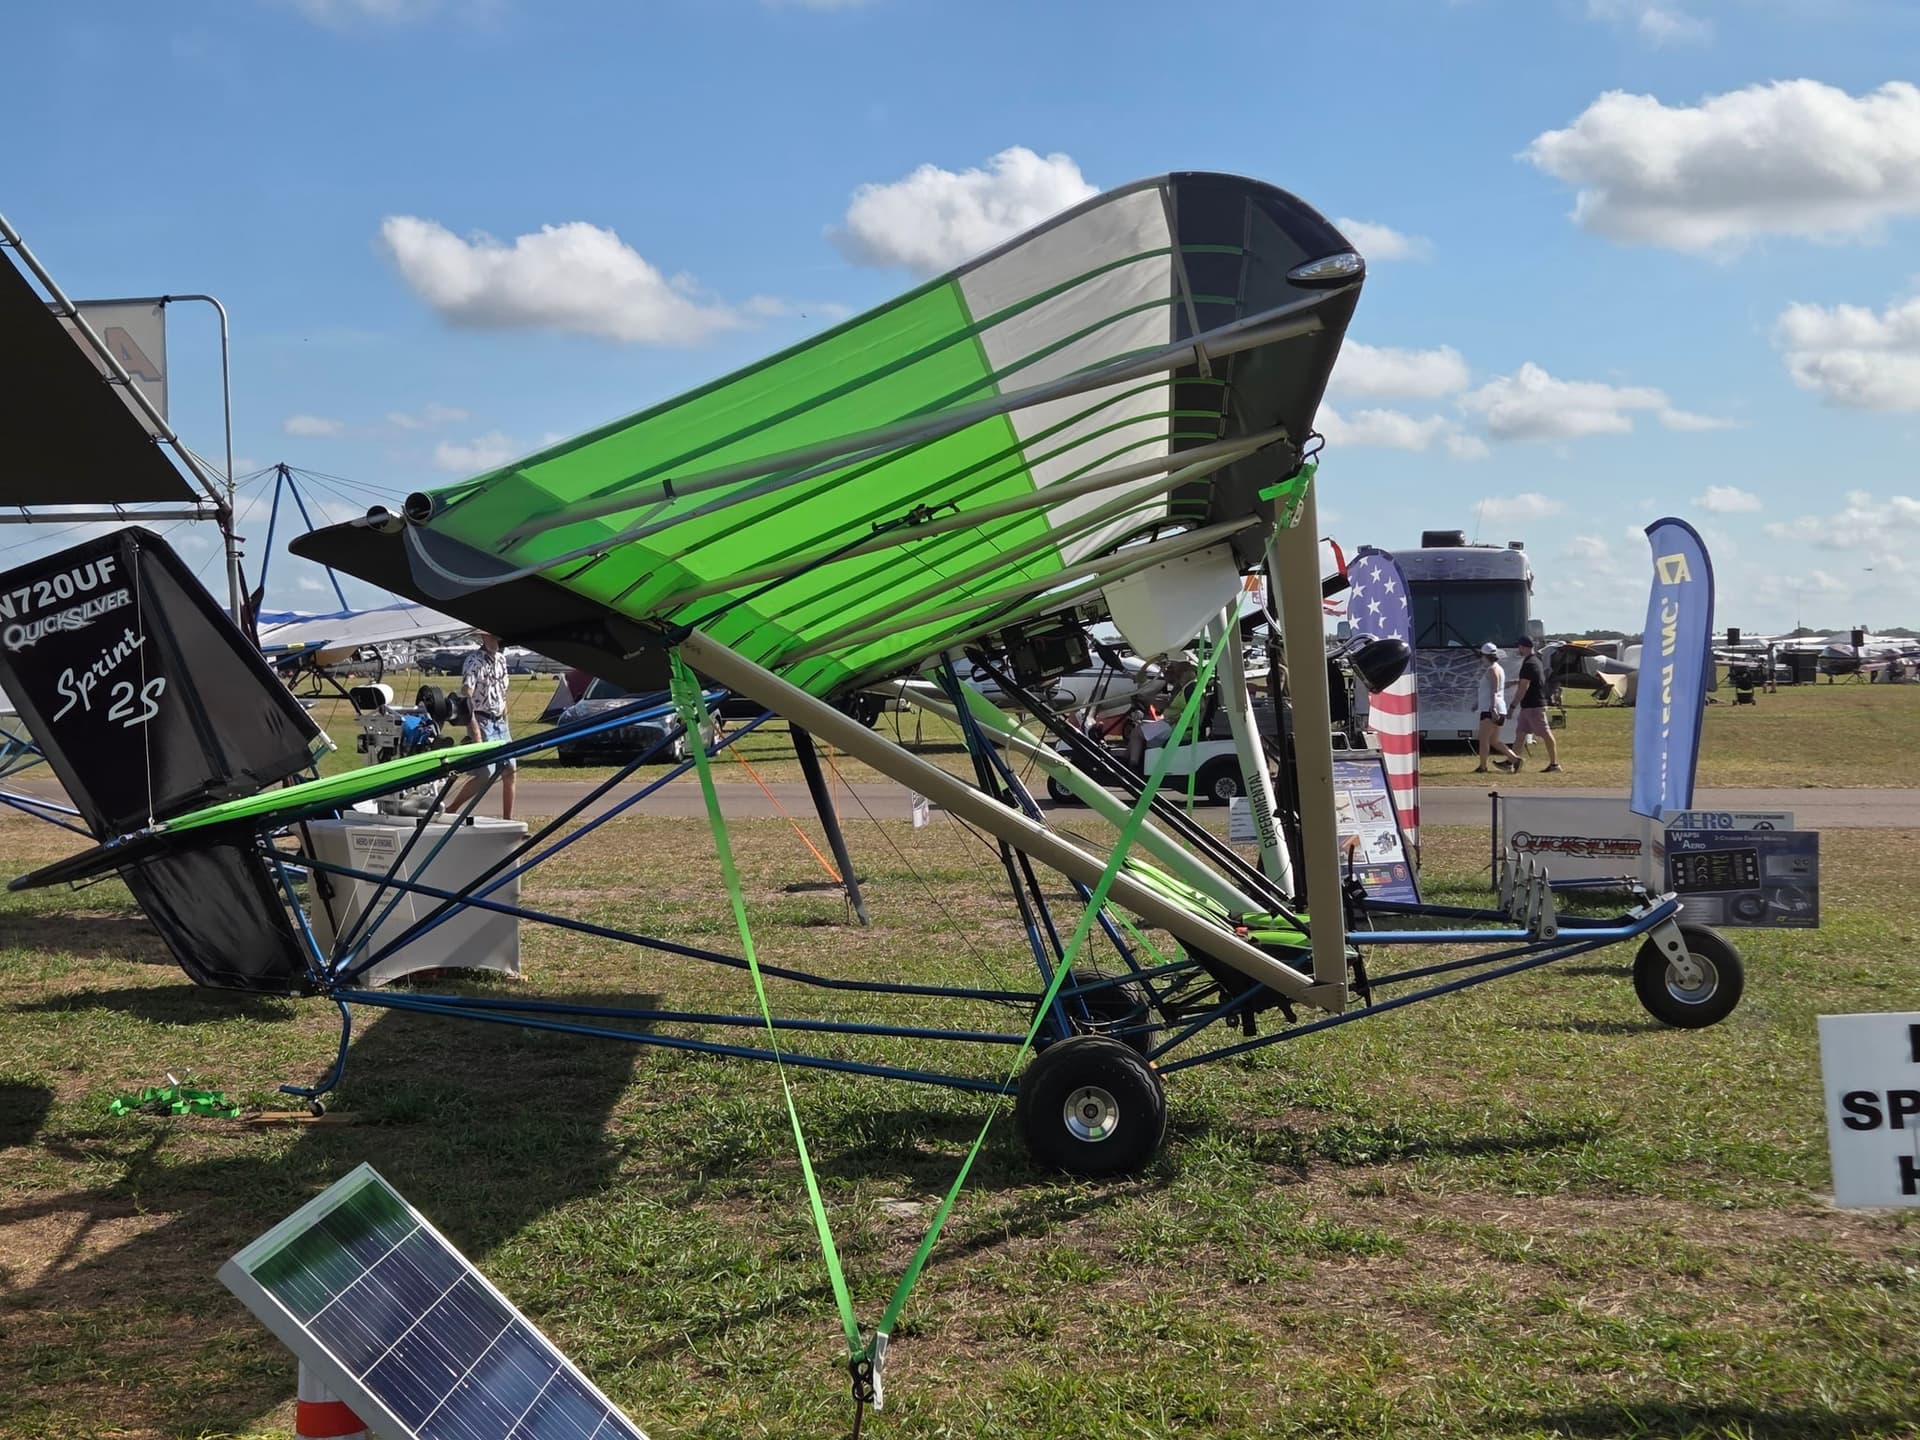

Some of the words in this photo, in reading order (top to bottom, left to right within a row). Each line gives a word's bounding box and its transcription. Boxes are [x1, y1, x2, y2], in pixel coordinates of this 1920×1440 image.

[0, 556, 117, 622] N720UF
[3, 588, 133, 653] QUICKSILVER
[54, 628, 147, 722] Sprint
[108, 677, 167, 728] 2S
[1248, 770, 1278, 849] EXPERIMENTAL
[1511, 831, 1642, 859] QUICKSILVER
